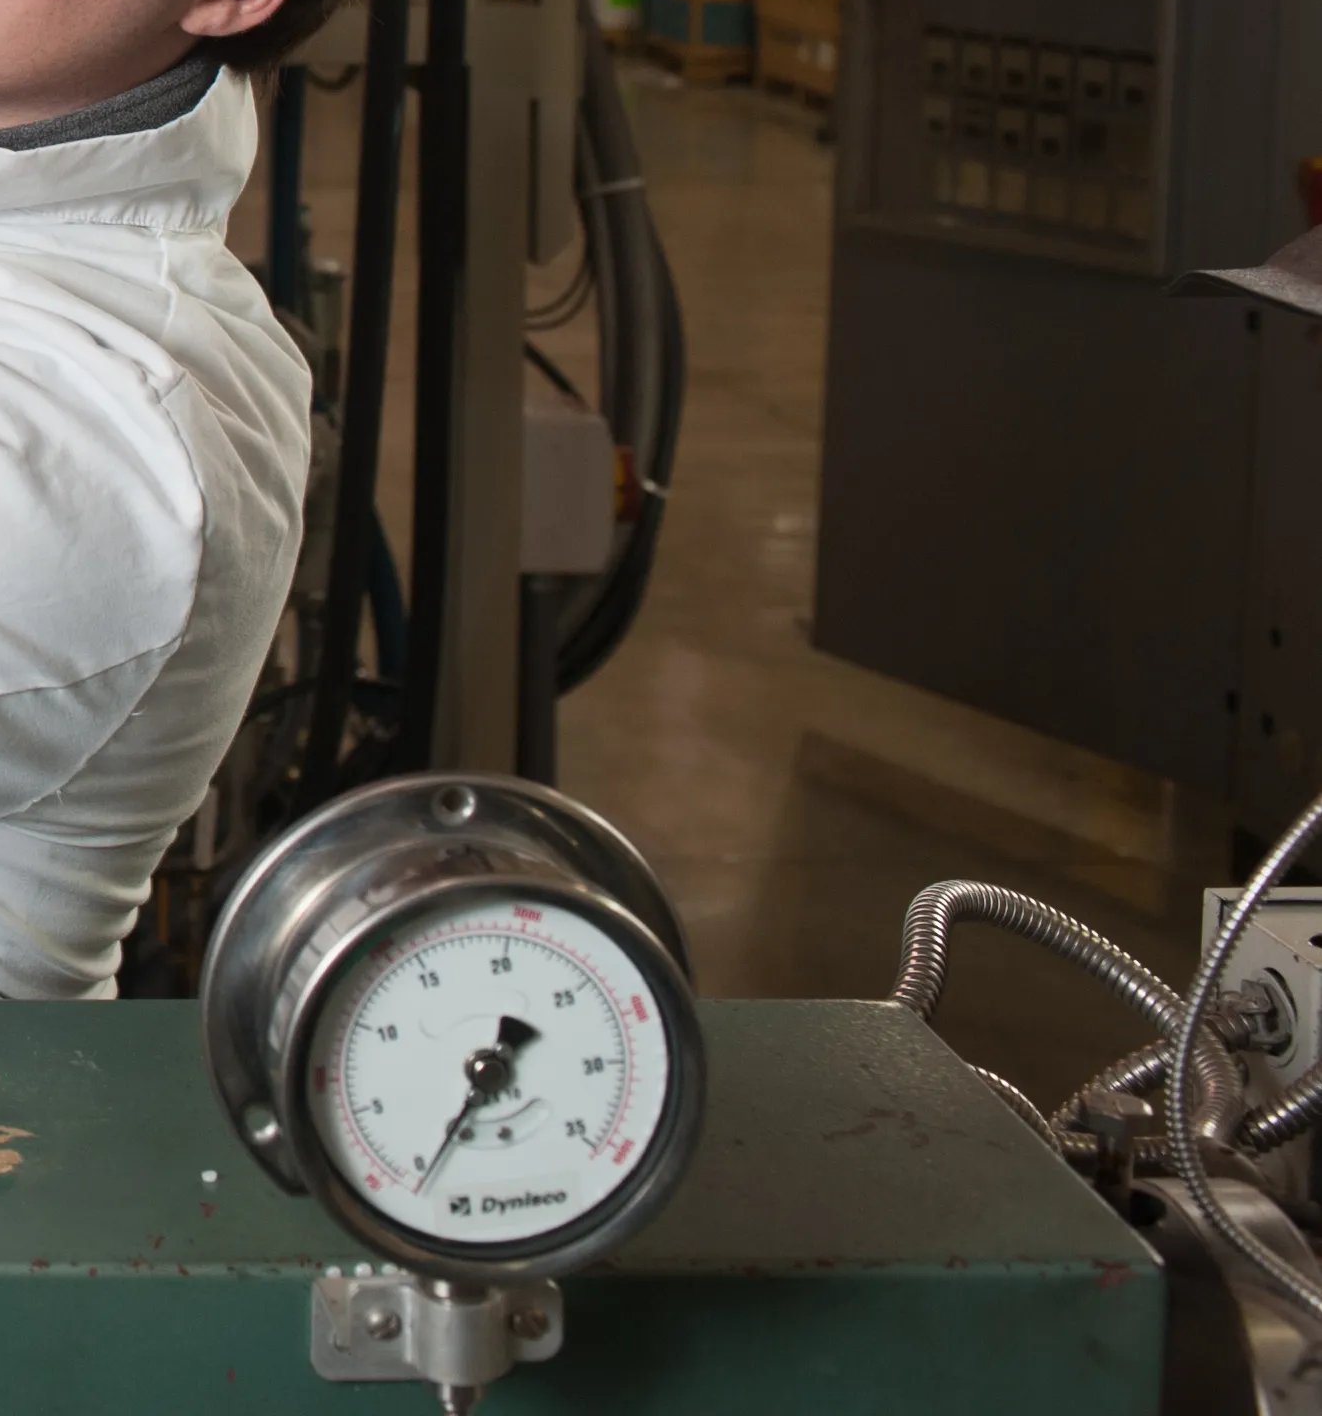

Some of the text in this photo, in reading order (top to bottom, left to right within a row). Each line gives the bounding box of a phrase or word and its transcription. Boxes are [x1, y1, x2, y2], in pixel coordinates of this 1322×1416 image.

[490, 956, 513, 975] 20
[419, 971, 441, 989] 15
[553, 990, 575, 1008] 25
[377, 1024, 398, 1042] 10
[583, 1056, 604, 1076] 30
[371, 1097, 384, 1115] 5
[565, 1117, 586, 1138] 35
[413, 1154, 426, 1172] 0
[481, 1189, 568, 1215] Dynisco
